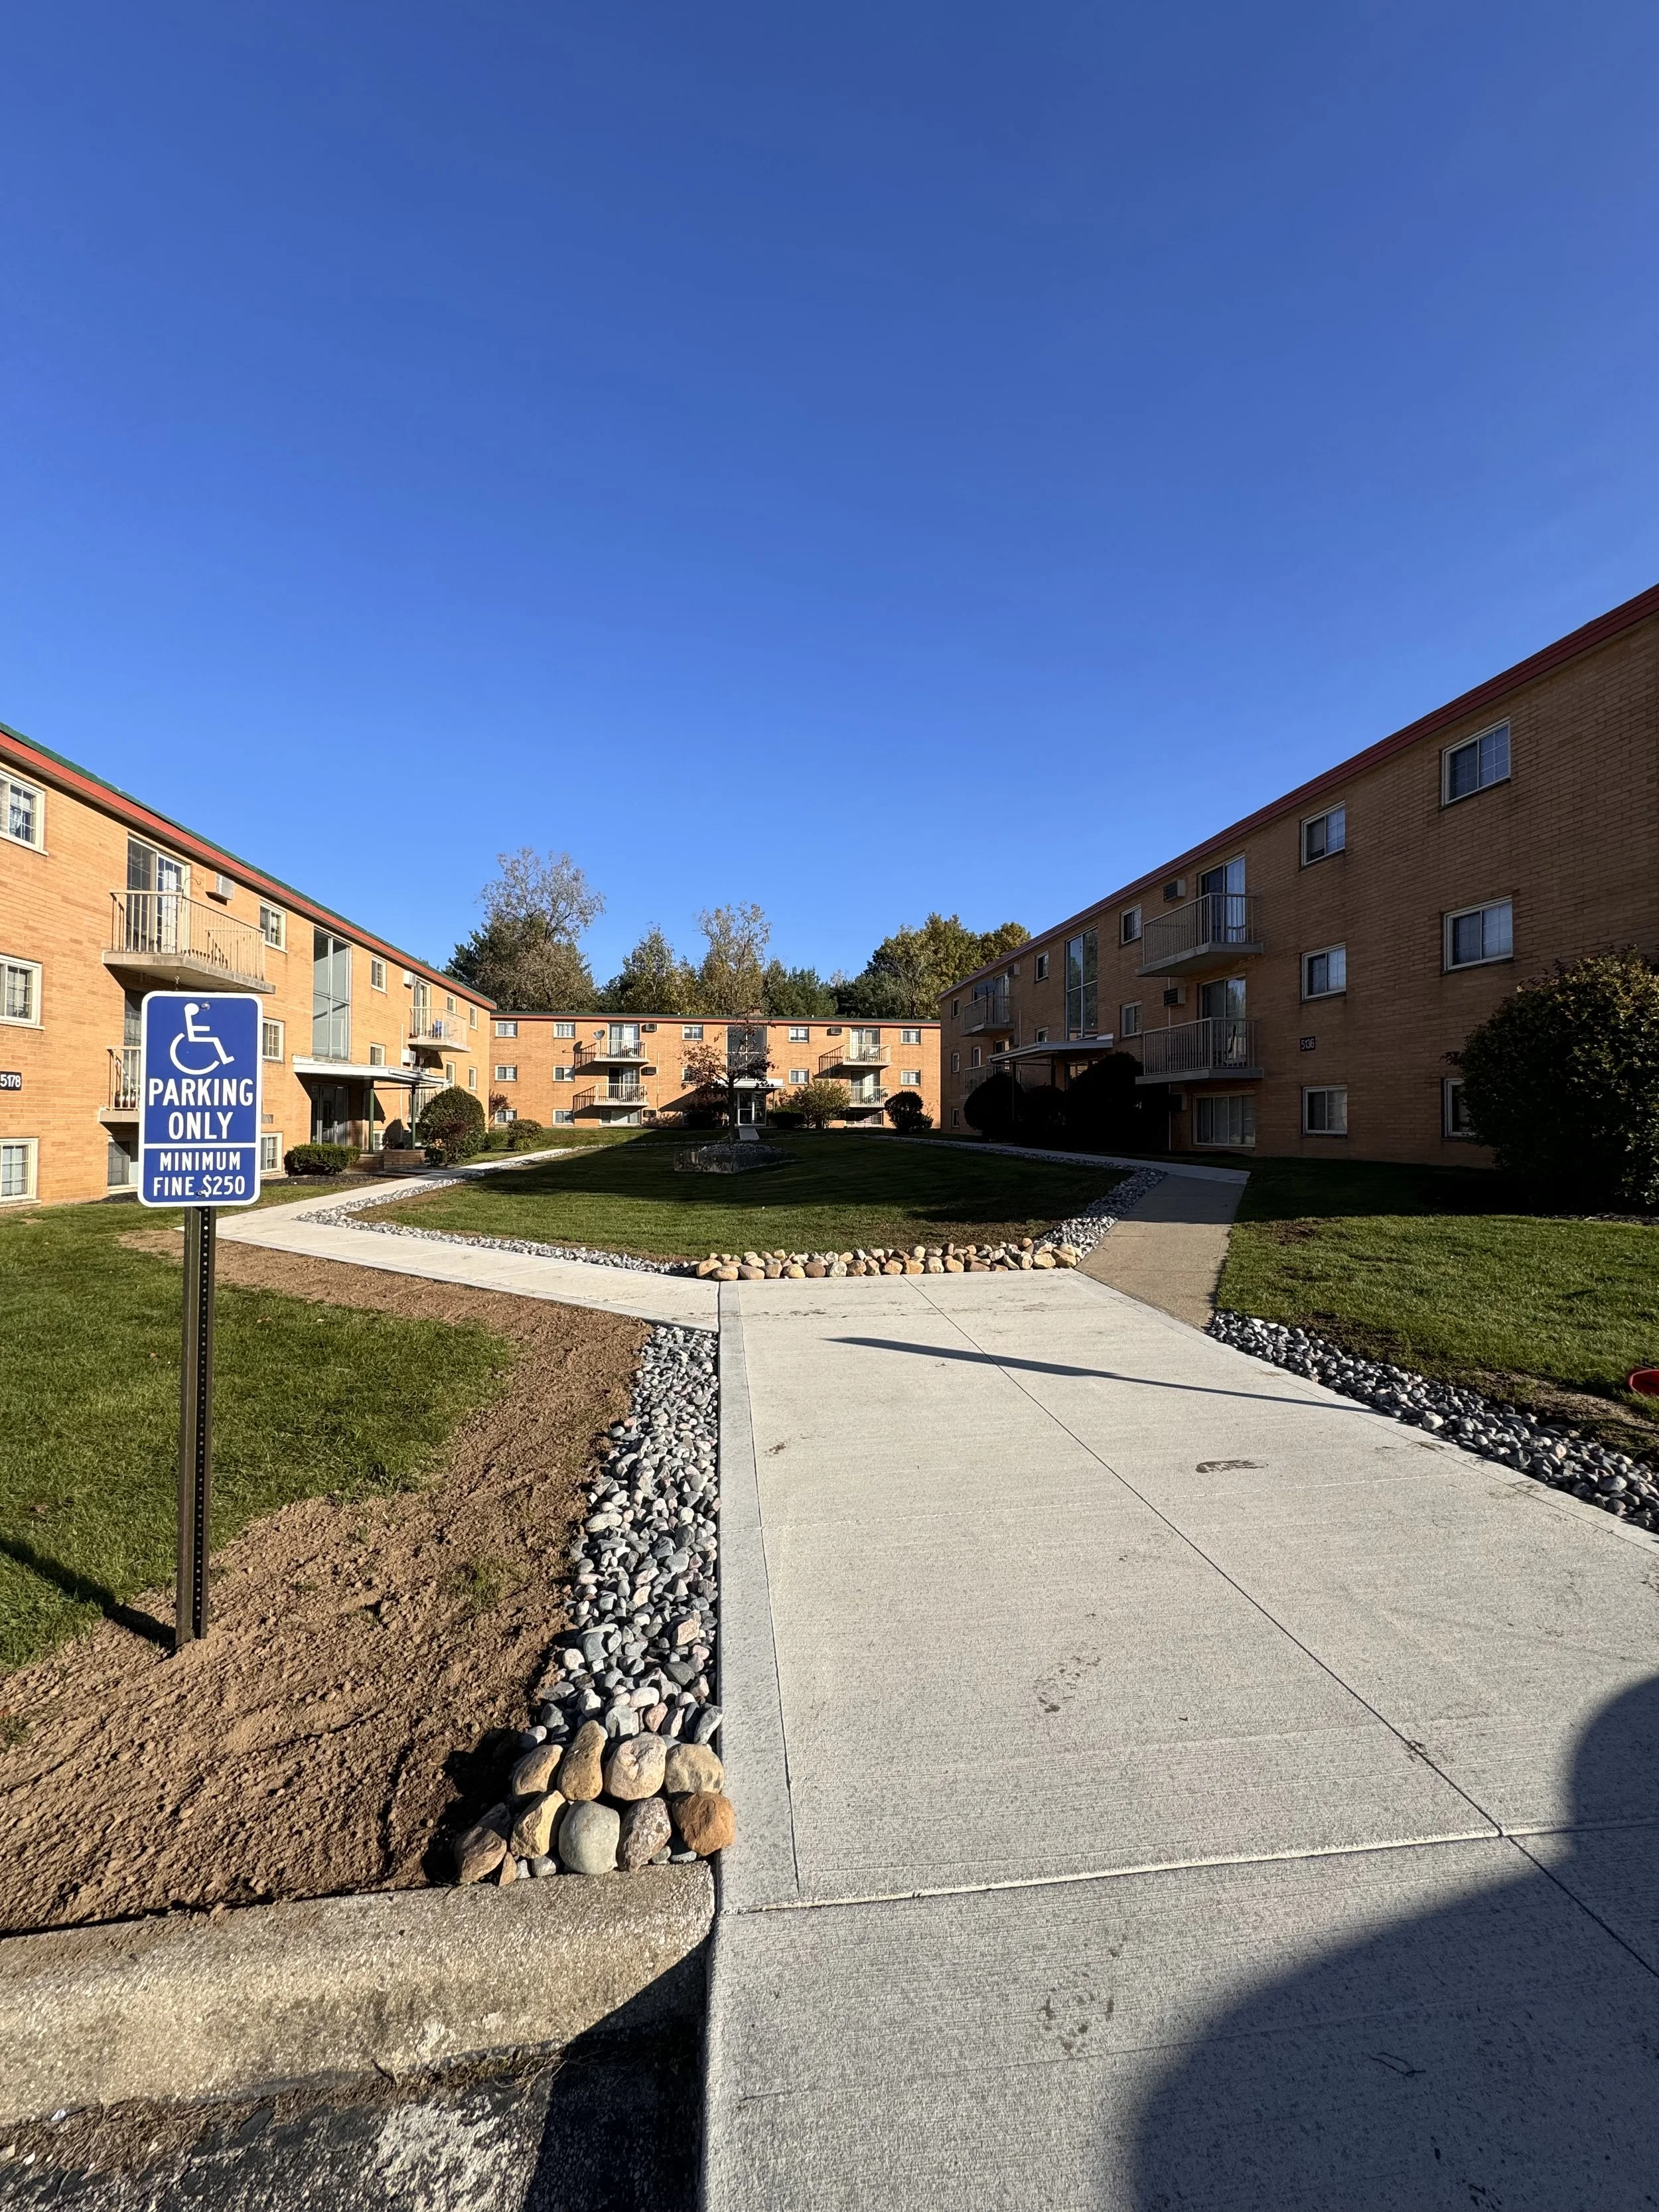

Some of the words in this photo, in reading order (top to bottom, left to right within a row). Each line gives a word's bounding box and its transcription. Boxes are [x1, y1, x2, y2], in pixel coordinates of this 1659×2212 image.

[0, 1074, 21, 1087] 5178
[149, 1078, 253, 1106] PARKING
[169, 1112, 234, 1140] ONLY
[160, 1151, 240, 1171] MINIMUM
[153, 1177, 194, 1197] FINE
[203, 1174, 246, 1197] $250
